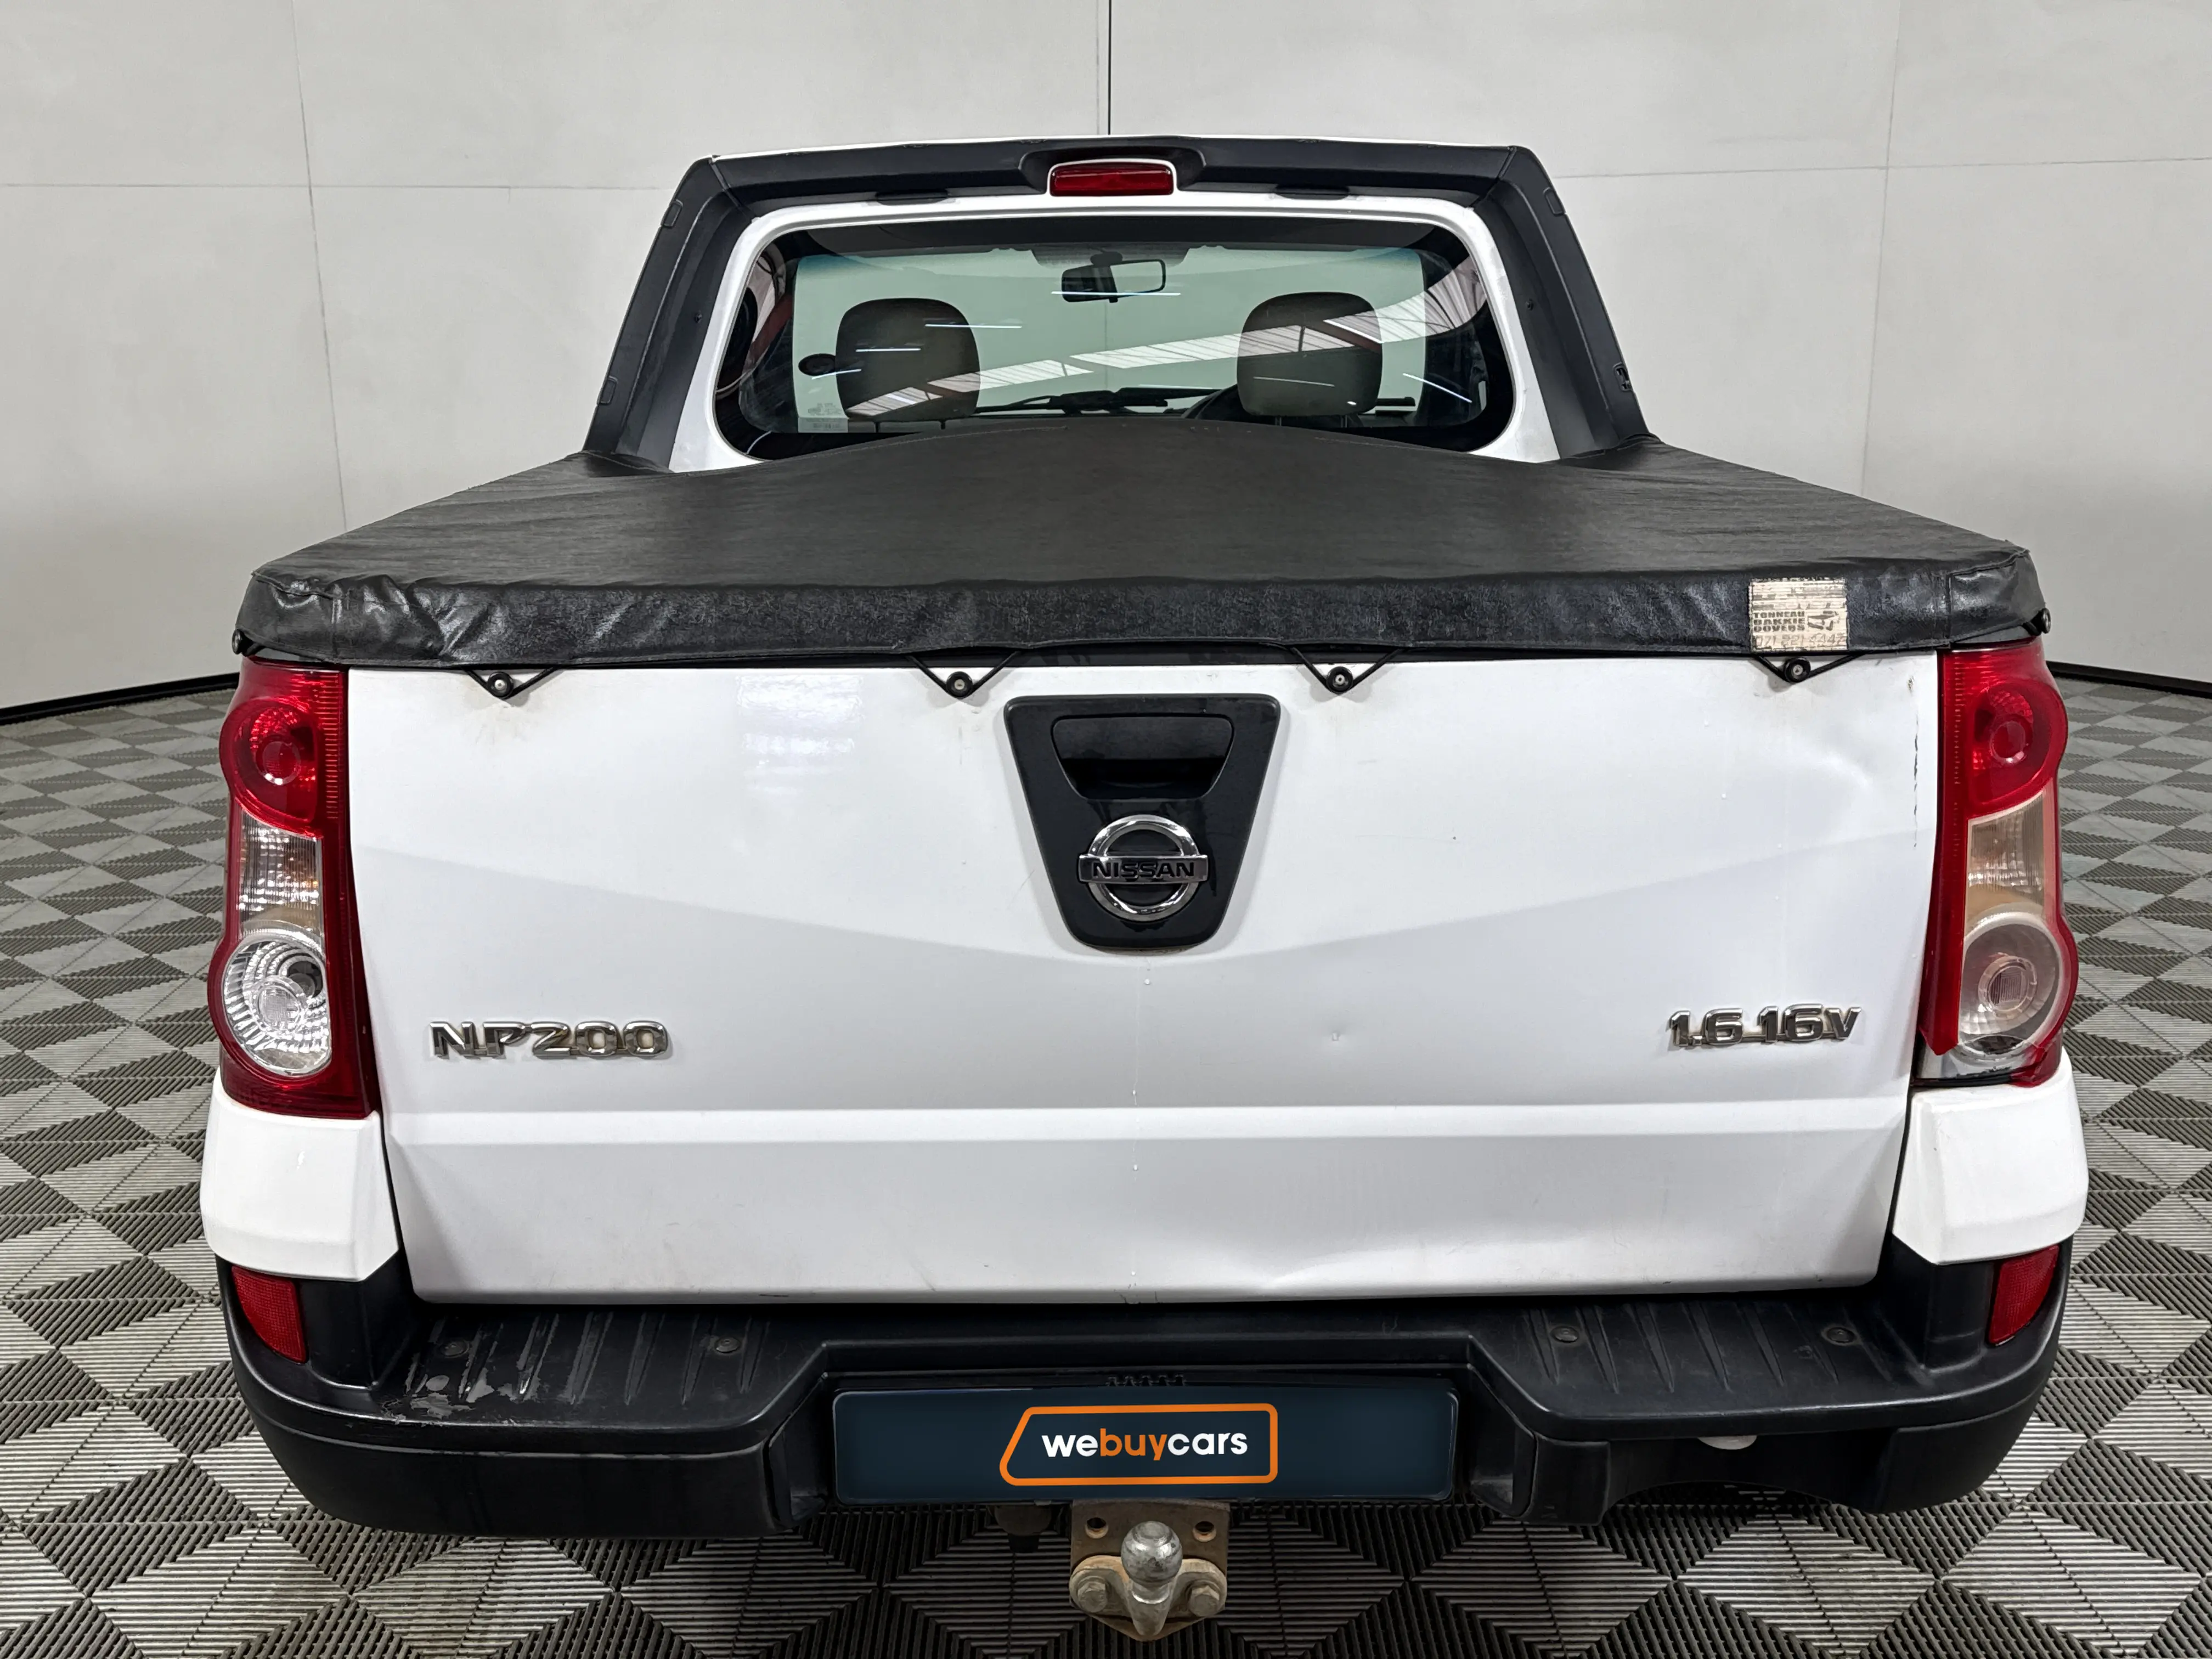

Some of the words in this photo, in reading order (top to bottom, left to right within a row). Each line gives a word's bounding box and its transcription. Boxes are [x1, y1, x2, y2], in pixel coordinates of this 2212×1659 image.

[1092, 862, 1194, 878] NISSAN
[430, 1021, 668, 1058] NP200
[1668, 1008, 1743, 1047] 1.6
